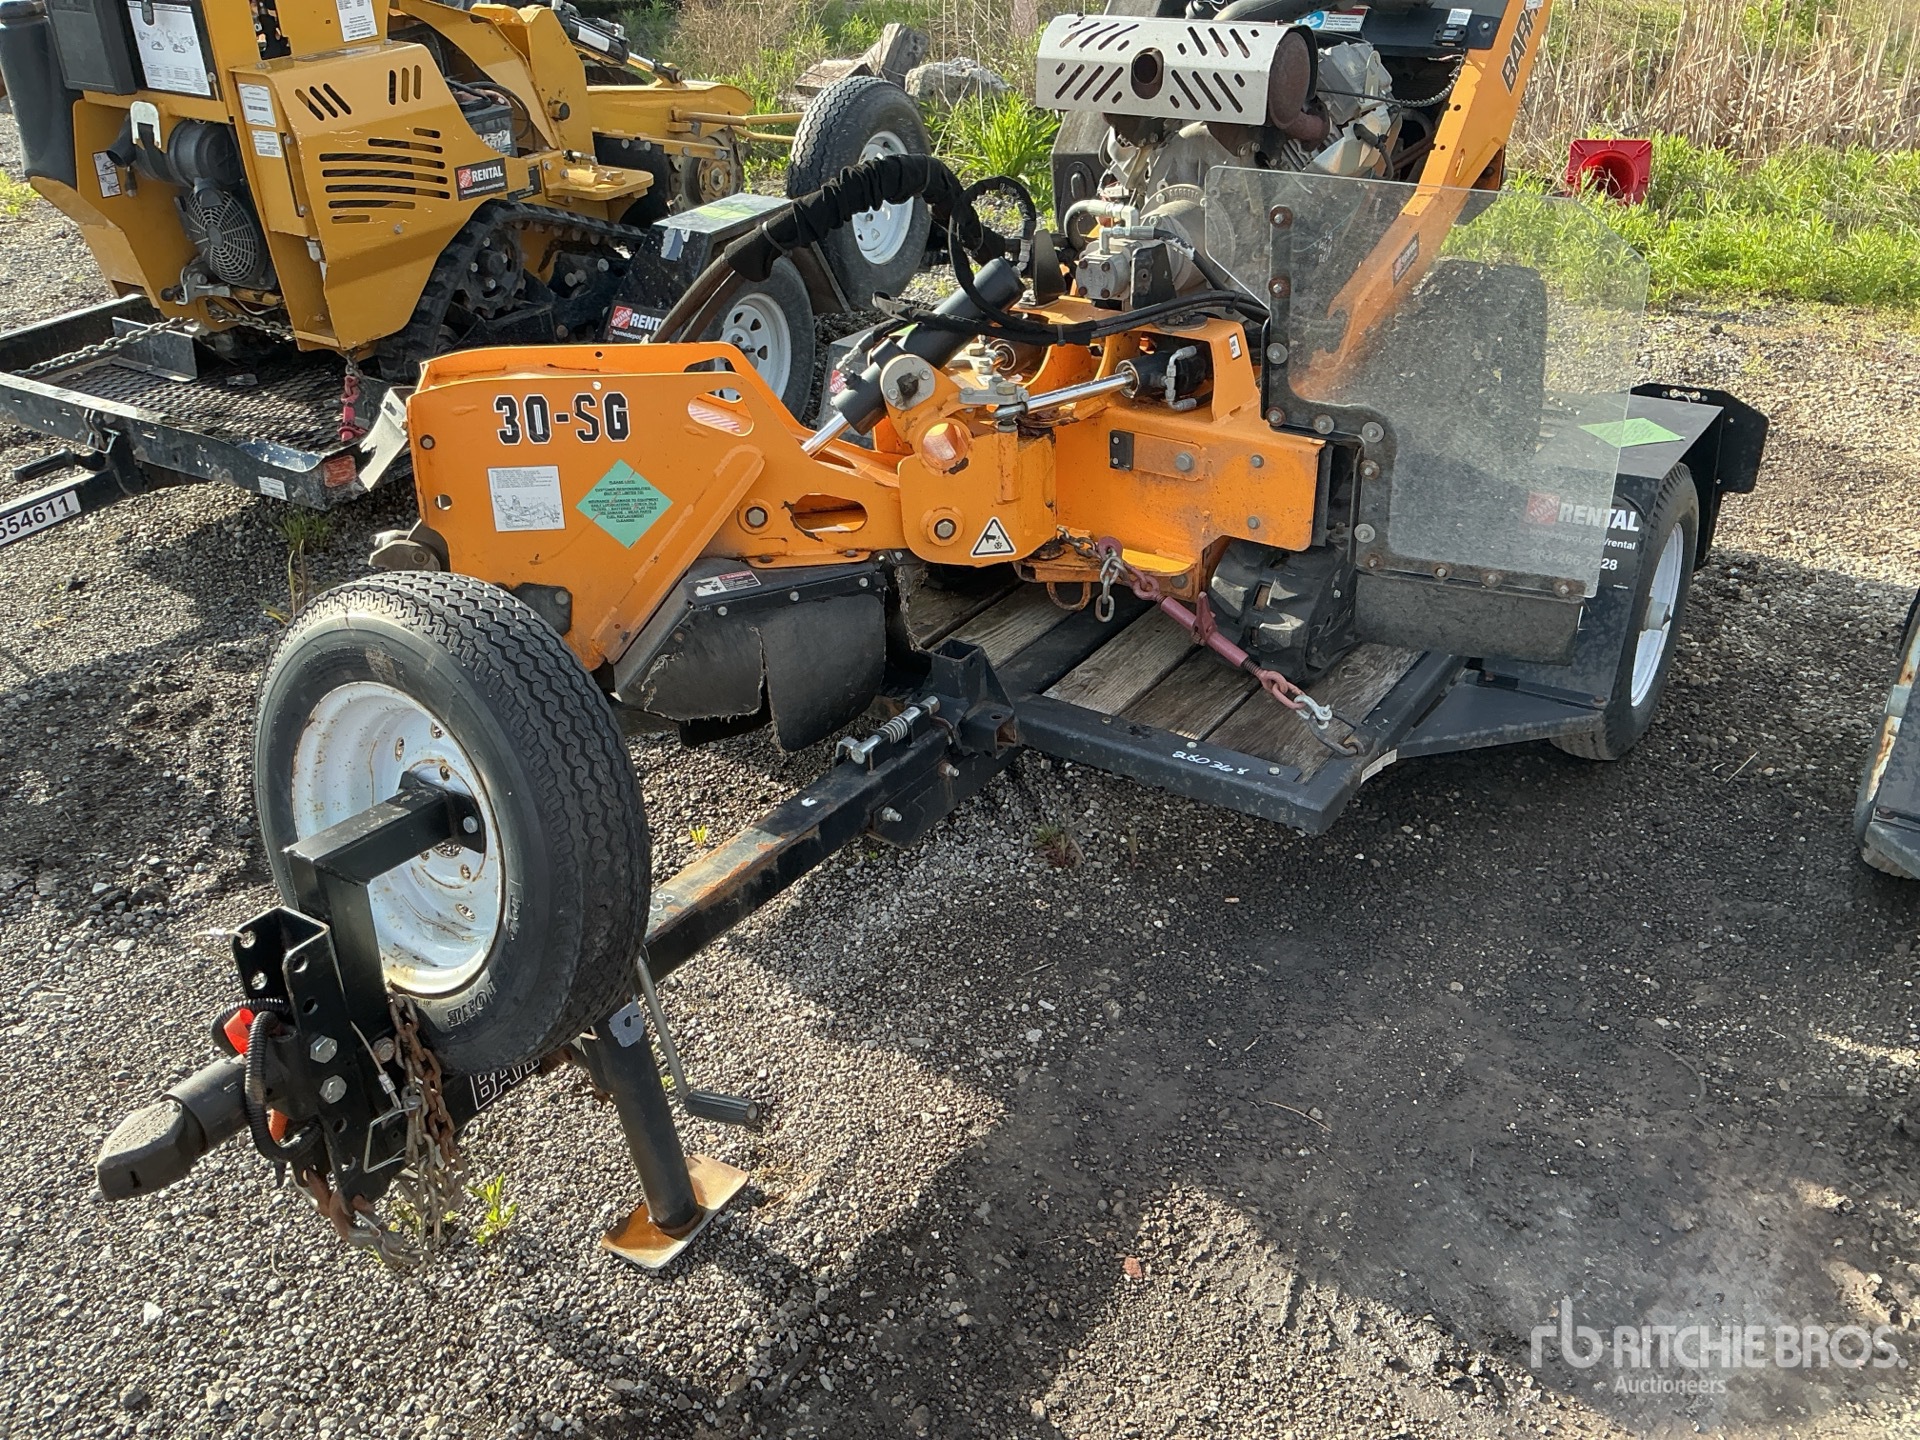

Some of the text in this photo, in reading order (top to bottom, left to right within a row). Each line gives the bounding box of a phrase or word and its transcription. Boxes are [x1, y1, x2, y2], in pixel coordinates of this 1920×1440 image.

[472, 166, 504, 182] RENTAL
[629, 313, 662, 331] RENT
[493, 391, 631, 446] 30-SG
[1558, 502, 1640, 532] RENTAL
